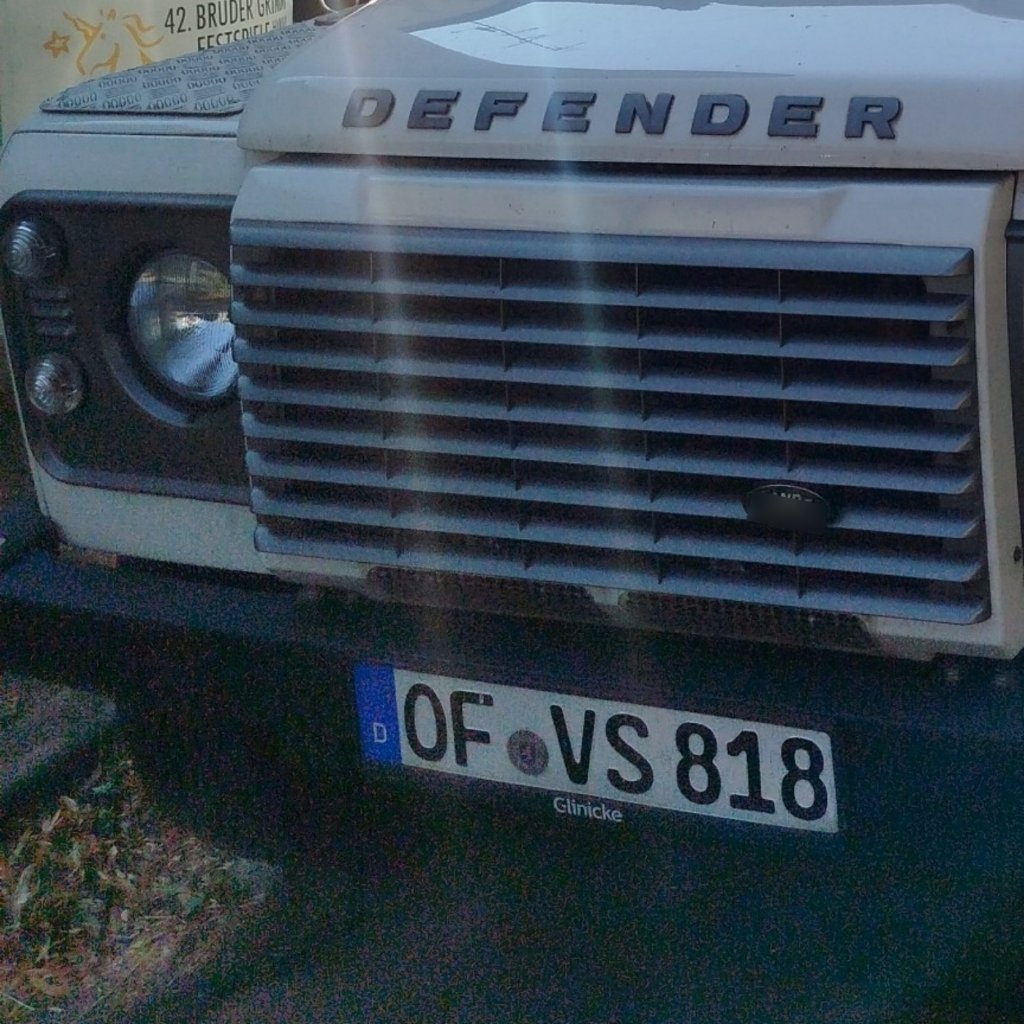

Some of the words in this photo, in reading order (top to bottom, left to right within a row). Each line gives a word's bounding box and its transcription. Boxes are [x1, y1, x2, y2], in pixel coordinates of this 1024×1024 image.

[164, 5, 192, 35] 42.
[341, 87, 902, 140] DEFENDER
[373, 721, 388, 743] D
[403, 683, 494, 767] OF
[549, 704, 655, 795] VS
[675, 720, 829, 822] 818
[552, 795, 624, 823] Glinicke
